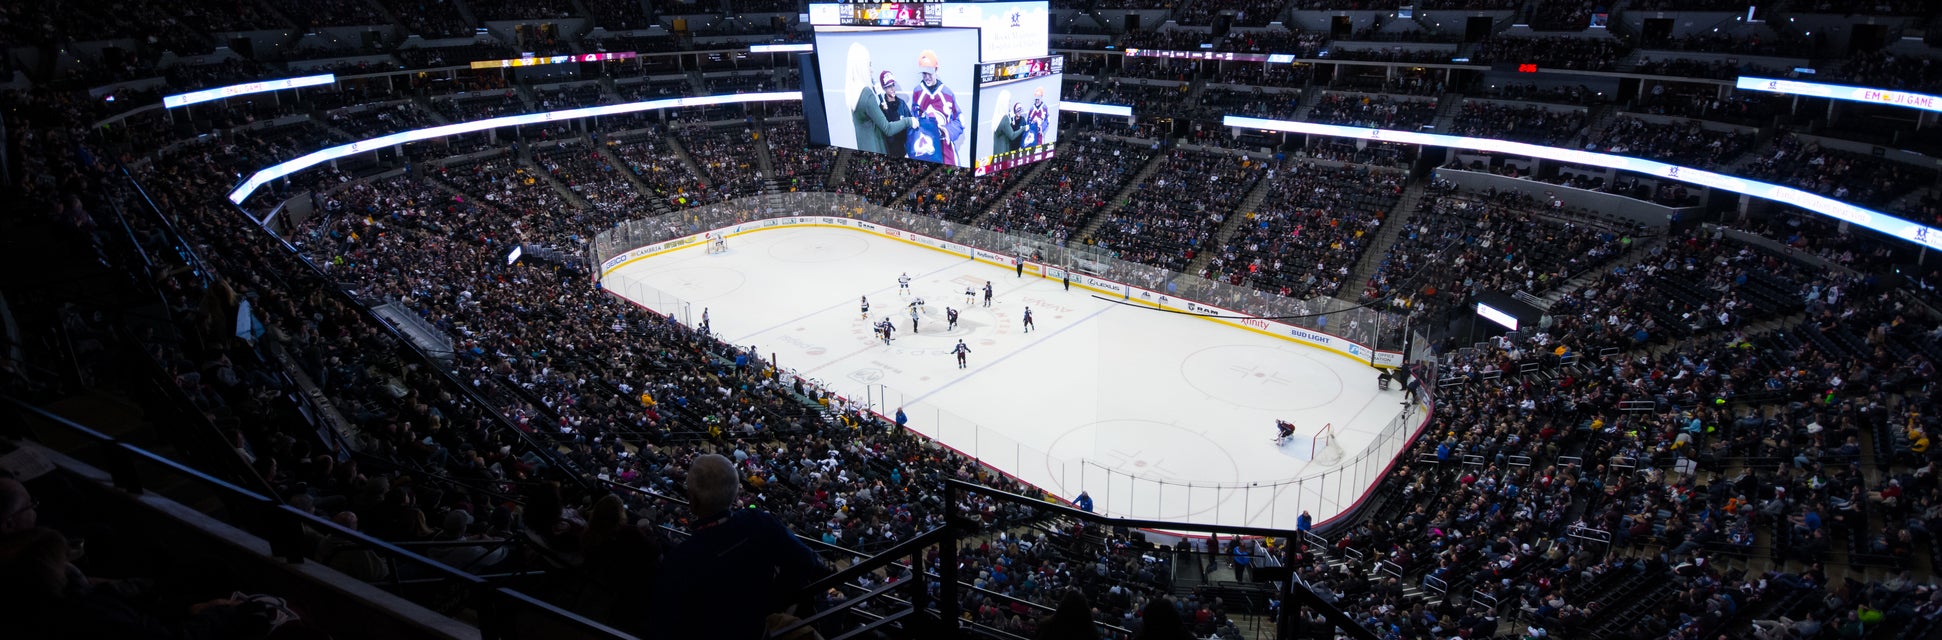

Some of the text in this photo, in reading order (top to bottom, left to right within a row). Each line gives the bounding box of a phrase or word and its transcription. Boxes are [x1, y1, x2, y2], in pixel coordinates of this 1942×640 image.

[1907, 95, 1934, 107] GAME
[606, 254, 627, 269] GEICO
[1095, 281, 1120, 291] LEXUS
[1196, 306, 1219, 315] RAM
[1291, 329, 1330, 343] BUD LIGHT
